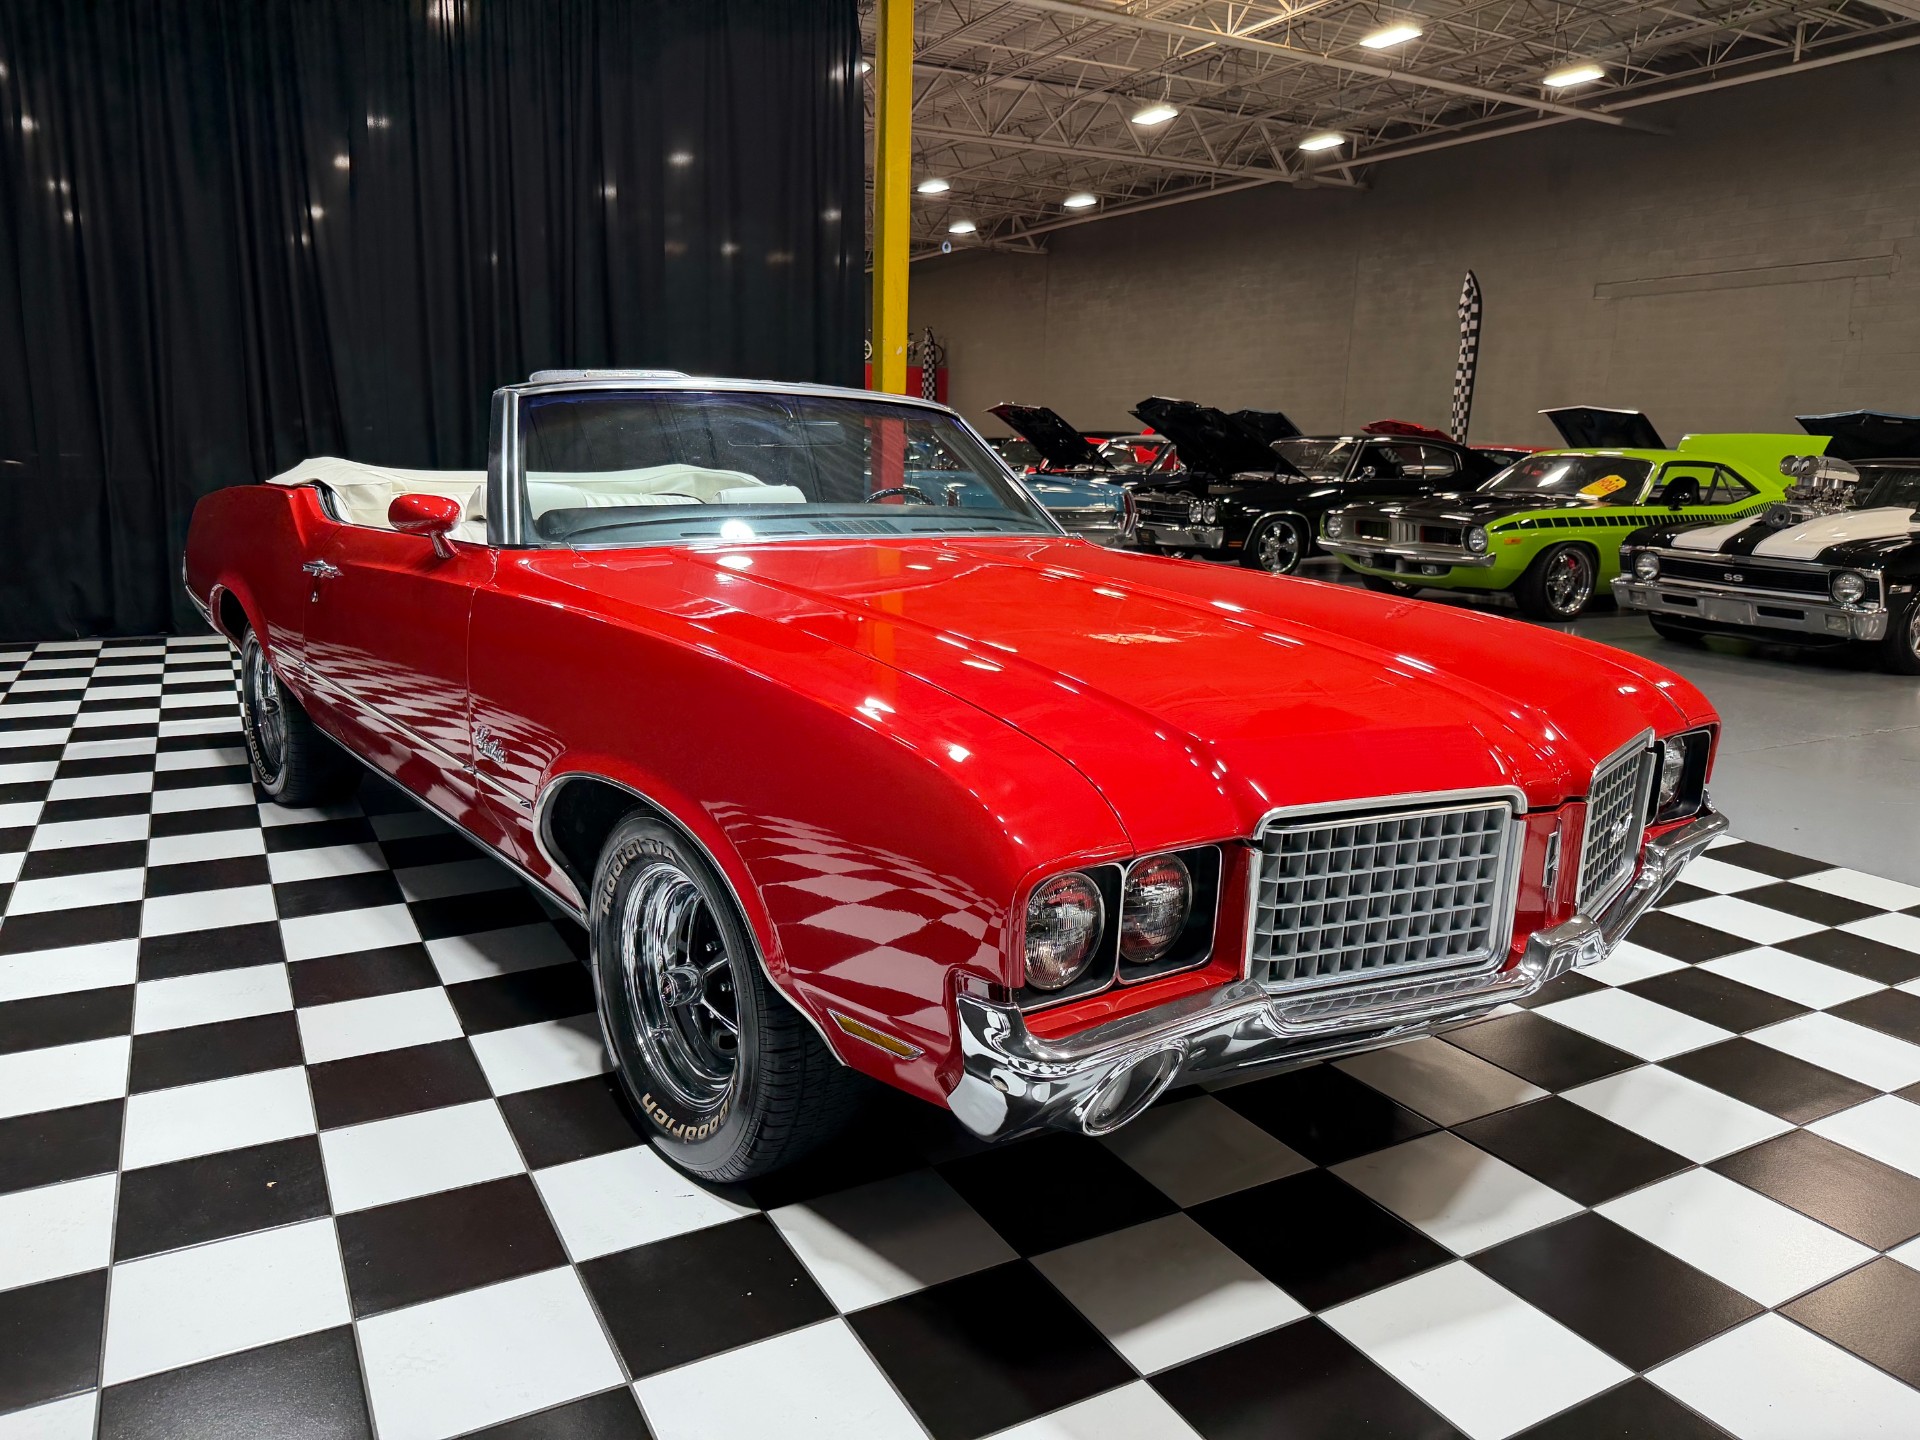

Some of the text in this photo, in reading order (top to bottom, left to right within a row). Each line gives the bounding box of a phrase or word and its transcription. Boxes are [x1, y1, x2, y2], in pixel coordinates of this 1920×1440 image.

[1723, 573, 1744, 582] SS
[601, 838, 678, 915] Radial T/A
